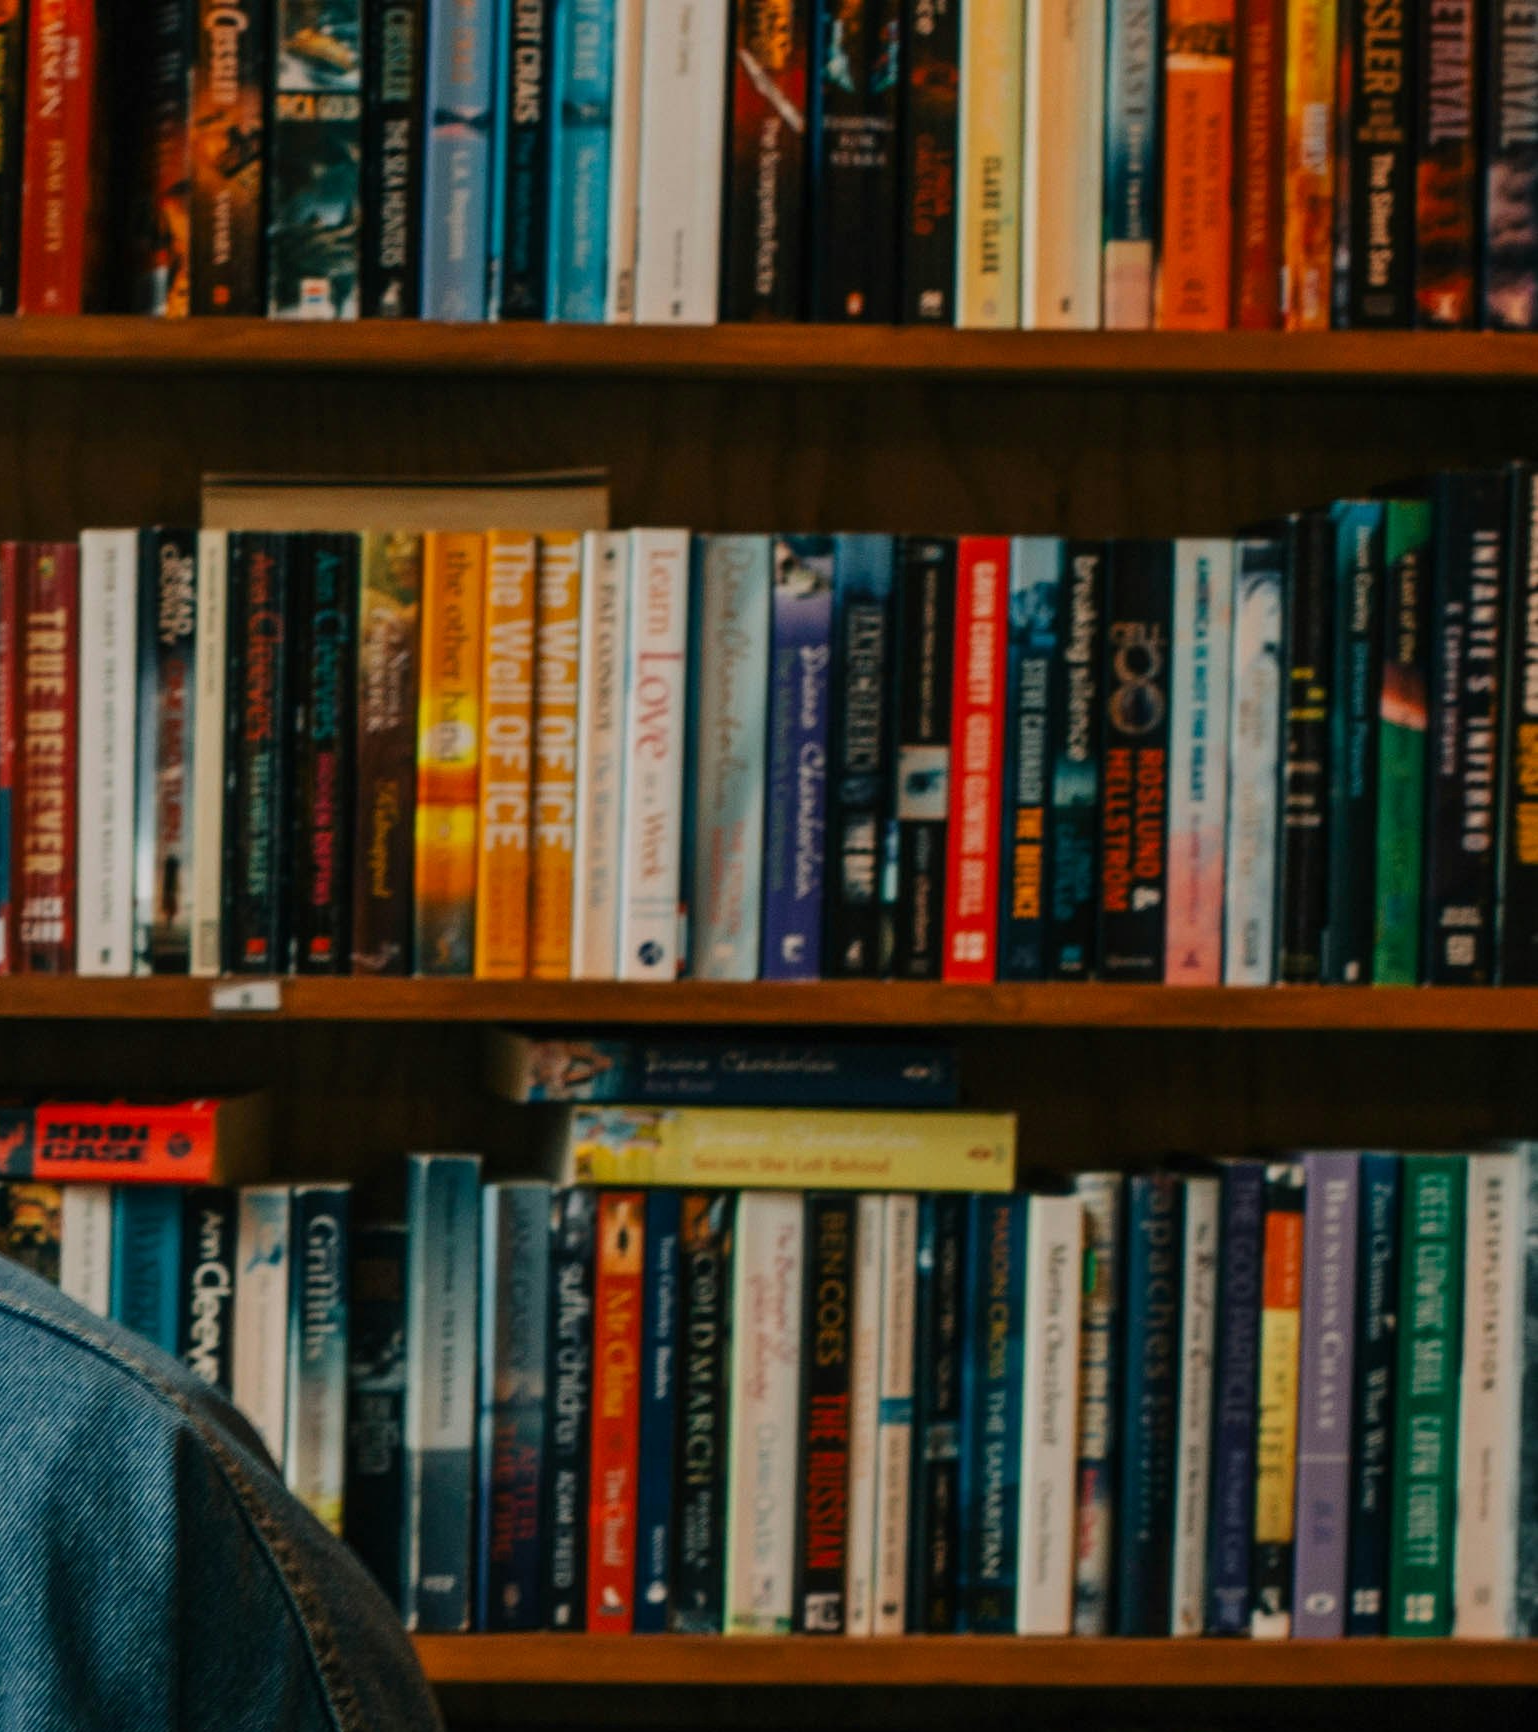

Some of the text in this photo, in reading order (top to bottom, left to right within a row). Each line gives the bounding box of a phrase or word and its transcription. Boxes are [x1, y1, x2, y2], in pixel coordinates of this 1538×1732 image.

[513, 49, 539, 124] CRAIS
[380, 189, 407, 268] HUNTERS
[1368, 154, 1394, 286] The Silent Sea
[442, 550, 474, 597] the
[644, 548, 678, 637] Learn
[971, 561, 996, 617] GAVIN
[245, 551, 284, 742] Ann Cleeves
[309, 551, 349, 741] Ann Cleeves
[442, 603, 473, 680] other
[484, 540, 533, 852] The Well OF ICE
[537, 540, 579, 850] The Well OF ICE
[1020, 658, 1046, 708] STEVE
[1065, 555, 1098, 762] breaking silence
[23, 607, 68, 876] TRUE BELIEVER
[639, 812, 674, 884] Week
[1015, 807, 1043, 840] THE
[1102, 748, 1131, 912] HELLSTRÖM
[1133, 749, 1162, 911] ROSLUND &
[1011, 844, 1041, 920] DEFENCE
[1416, 1172, 1451, 1237] GREEN
[301, 1214, 339, 1361] Griffiths
[1044, 1243, 1066, 1319] Martin
[685, 1253, 716, 1486] COLD MARCH
[807, 1211, 848, 1569] BEN COES THE RUSSIAN
